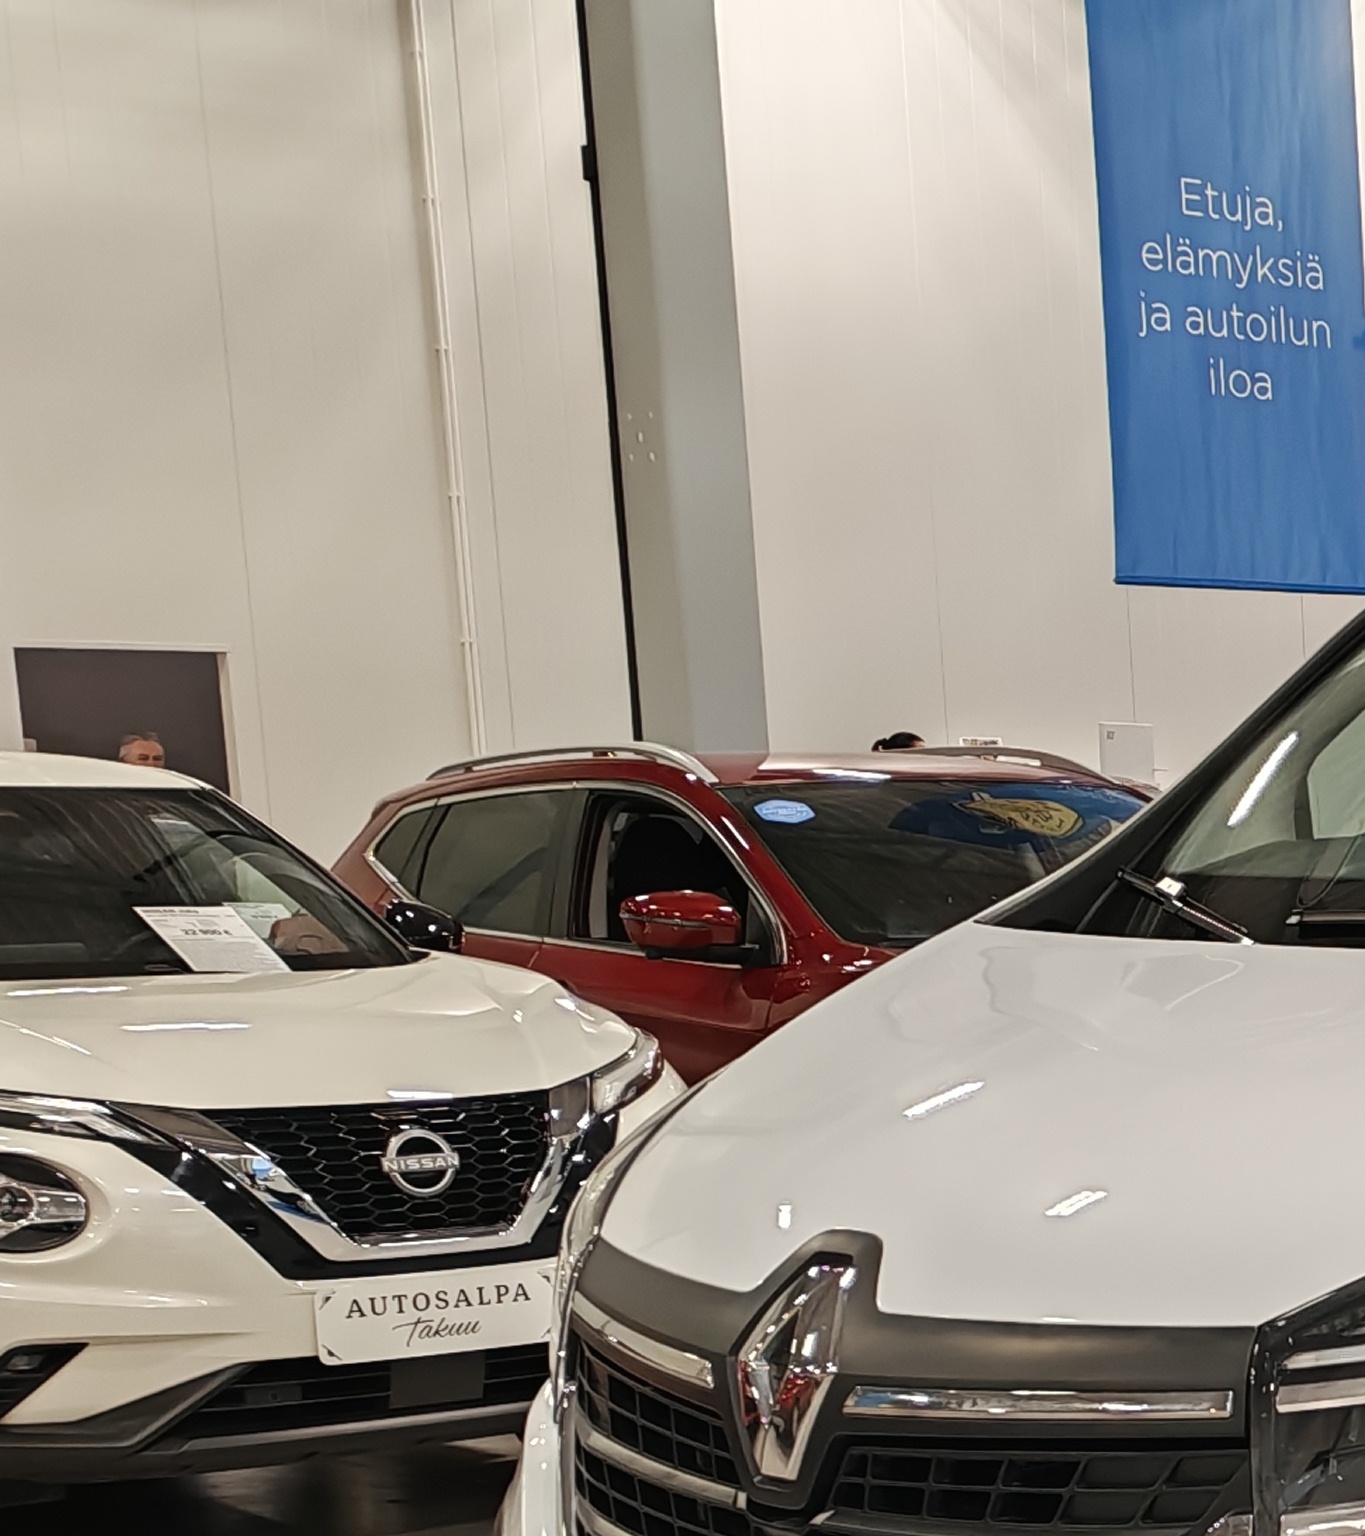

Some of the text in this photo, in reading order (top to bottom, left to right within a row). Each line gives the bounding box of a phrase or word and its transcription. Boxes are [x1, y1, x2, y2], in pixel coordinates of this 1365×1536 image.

[1180, 177, 1283, 232] Etuja,
[1141, 233, 1324, 290] elämyksiä
[1138, 290, 1331, 349] ja autoilun
[1209, 357, 1273, 401] iloa
[384, 1156, 459, 1173] NISSAN
[345, 1283, 532, 1320] AUTOSALPA
[392, 1317, 482, 1348] Takuu
